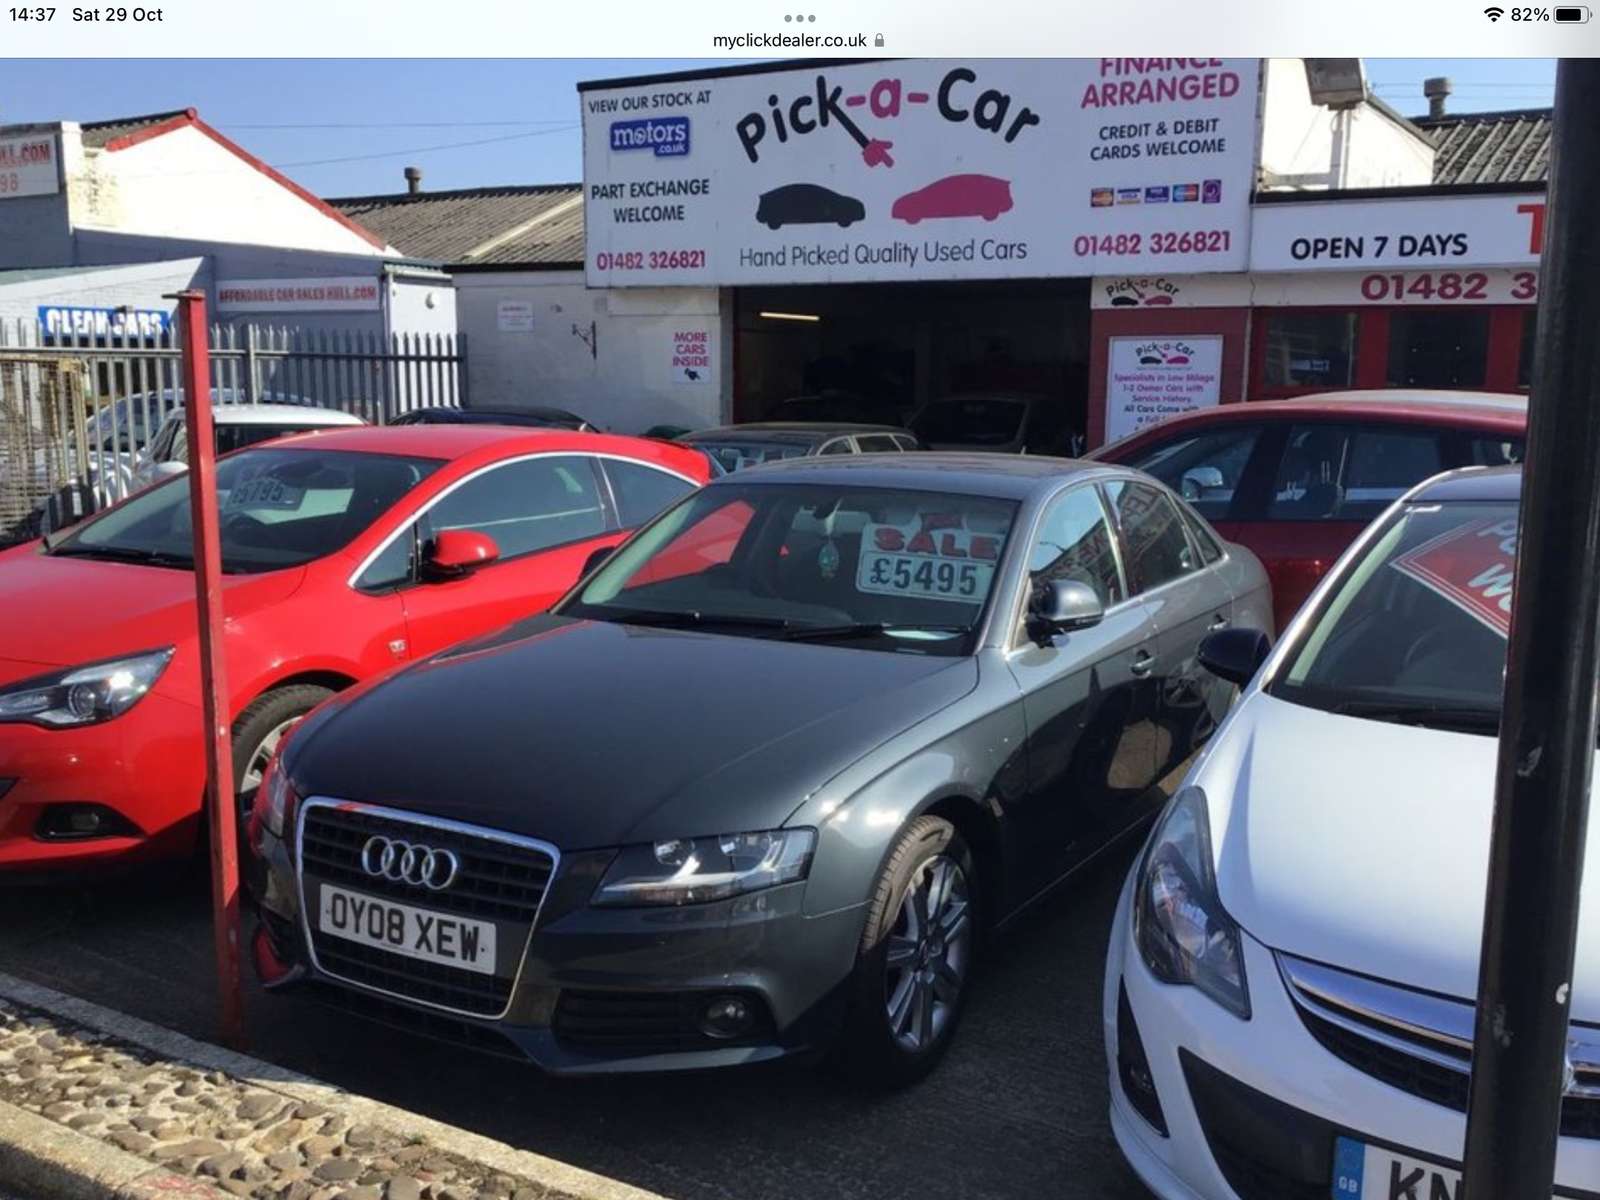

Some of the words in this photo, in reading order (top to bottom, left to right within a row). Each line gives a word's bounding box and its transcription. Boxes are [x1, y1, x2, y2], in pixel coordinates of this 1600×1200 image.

[588, 100, 618, 114] VIEW
[622, 96, 649, 111] OUR
[652, 92, 693, 108] STOCK
[697, 90, 711, 104] AT
[1081, 72, 1240, 108] ARRANGED
[613, 121, 687, 146] motors
[1099, 123, 1151, 140] CREDIT
[1155, 121, 1168, 136] &
[1173, 118, 1220, 135] DEBIT
[1090, 144, 1141, 161] CARDS
[1146, 138, 1226, 156] WELCOME
[591, 184, 625, 200] PART
[630, 179, 710, 198] EXCHANGE
[613, 205, 685, 223] WELCOME
[739, 246, 786, 267] Hand
[791, 244, 849, 266] Picked
[854, 242, 918, 268] Quality
[923, 239, 975, 262] Used
[981, 239, 1028, 260] Cars
[1073, 234, 1142, 257] 01482
[1150, 231, 1230, 254] 326821
[1290, 237, 1364, 260] OPEN
[1373, 236, 1389, 258] 7
[1398, 233, 1468, 257] DAYS
[596, 252, 644, 271] 01482
[648, 251, 706, 269] 326821
[1361, 272, 1489, 300] 01482
[674, 332, 708, 342] MORE
[672, 356, 709, 367] INSIDE
[676, 344, 706, 355] CARS
[874, 527, 999, 561] SALE
[870, 557, 977, 595] £5495
[331, 892, 405, 946] OY08
[415, 913, 479, 962] XEW
[1338, 1176, 1358, 1193] GB
[1389, 1160, 1462, 1200] KN
